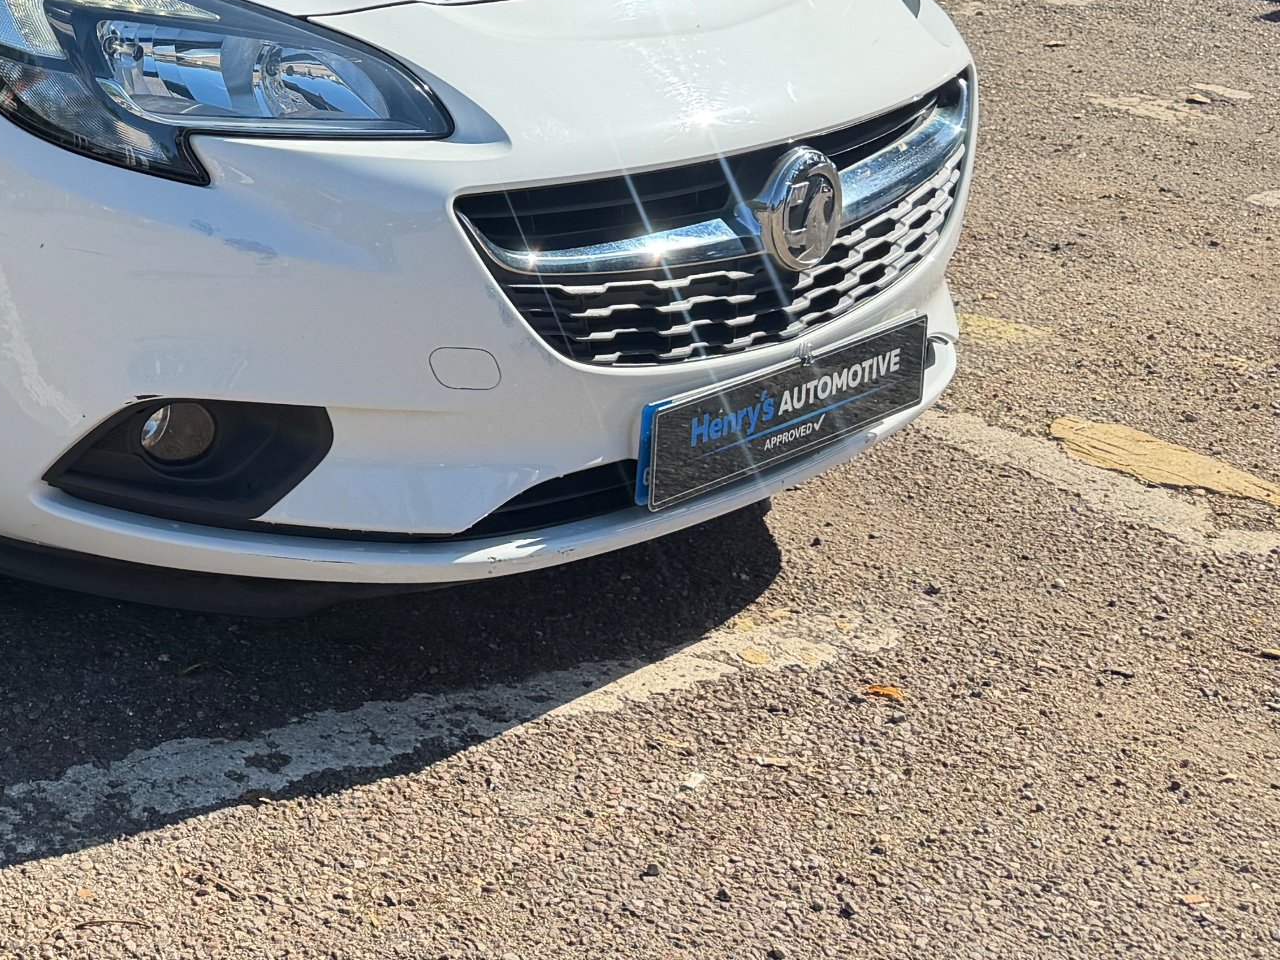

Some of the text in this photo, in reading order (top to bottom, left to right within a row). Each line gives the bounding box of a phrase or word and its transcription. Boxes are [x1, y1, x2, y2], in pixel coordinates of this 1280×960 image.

[690, 347, 901, 448] Henry's AUTOMOTIVE
[764, 423, 813, 451] APPROVED
